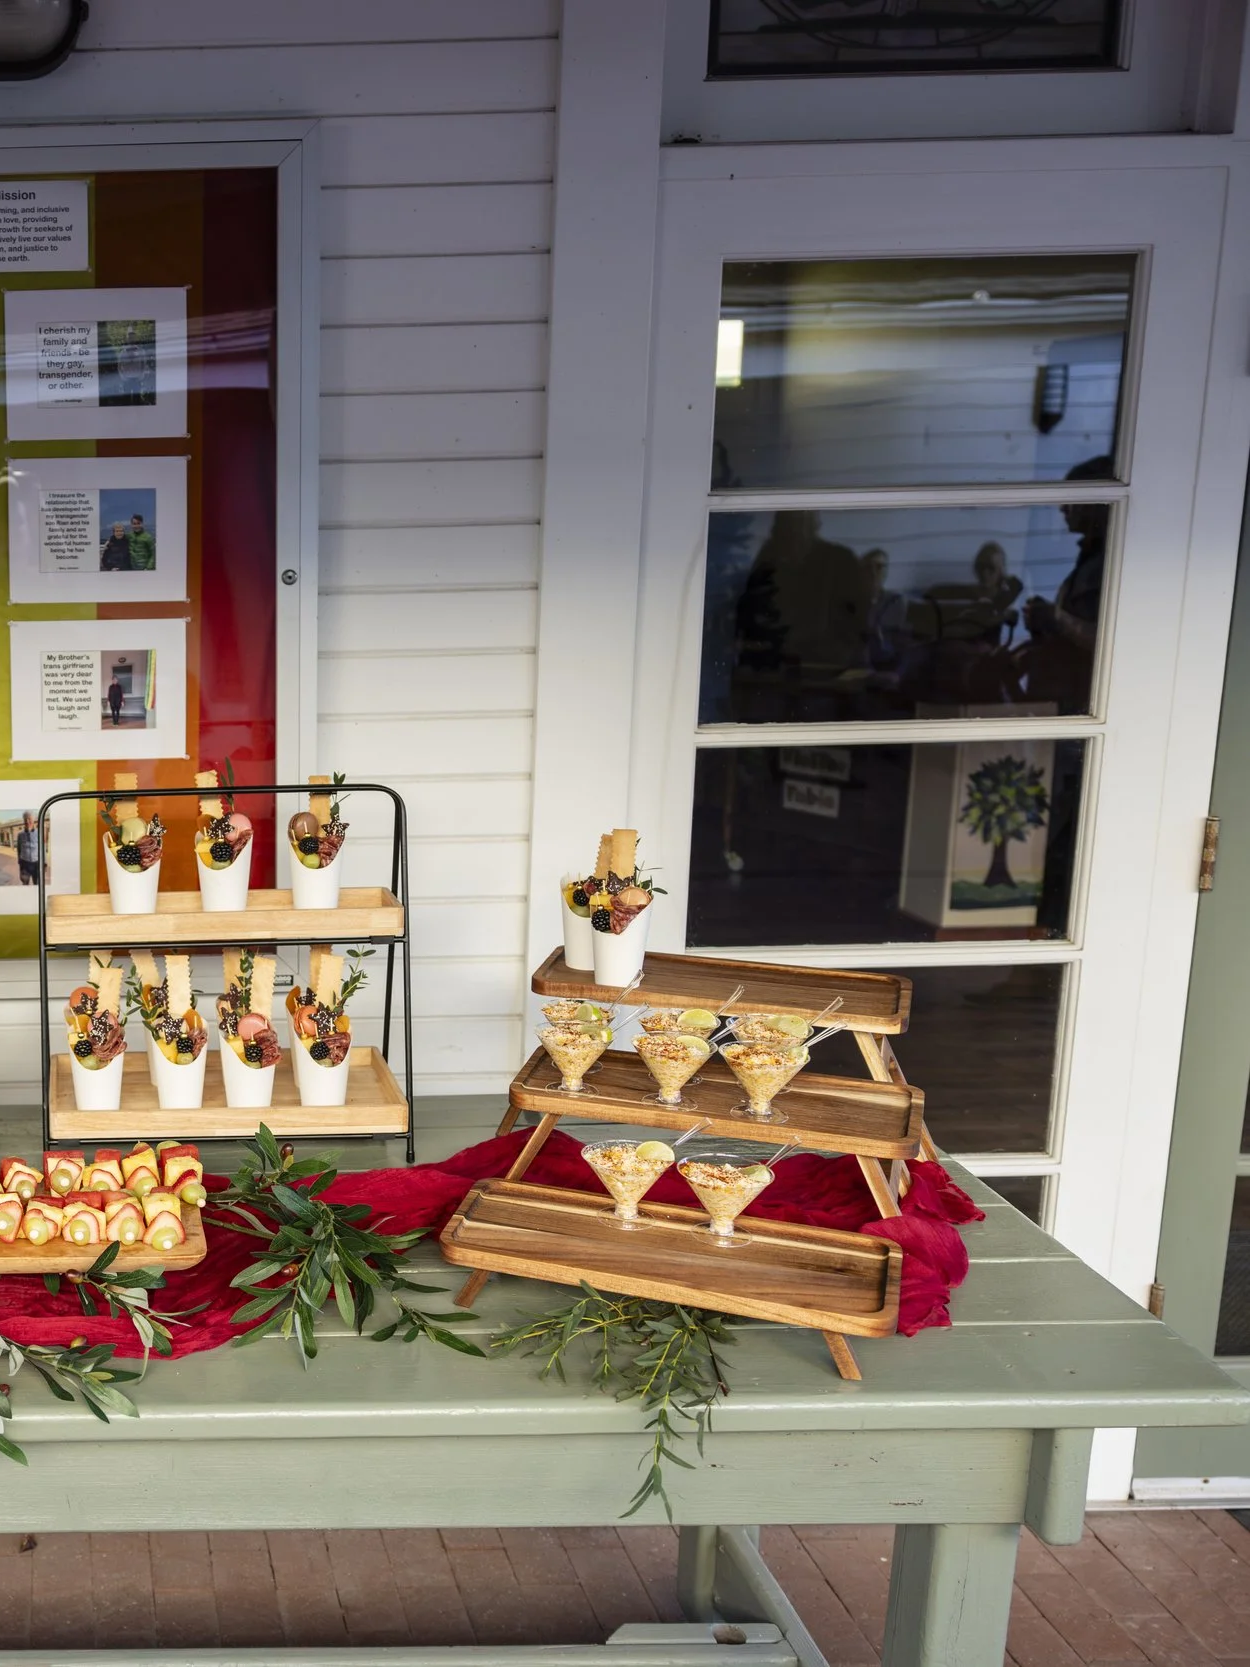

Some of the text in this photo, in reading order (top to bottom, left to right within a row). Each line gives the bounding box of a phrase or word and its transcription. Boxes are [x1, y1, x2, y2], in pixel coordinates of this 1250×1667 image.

[22, 215, 58, 223] providing
[47, 234, 71, 242] values
[23, 245, 49, 253] justice
[7, 254, 30, 262] earth.
[78, 327, 90, 335] my
[43, 337, 87, 347] family and
[41, 349, 71, 357] friends
[47, 360, 85, 369] they gay,
[39, 371, 93, 380] transgender,
